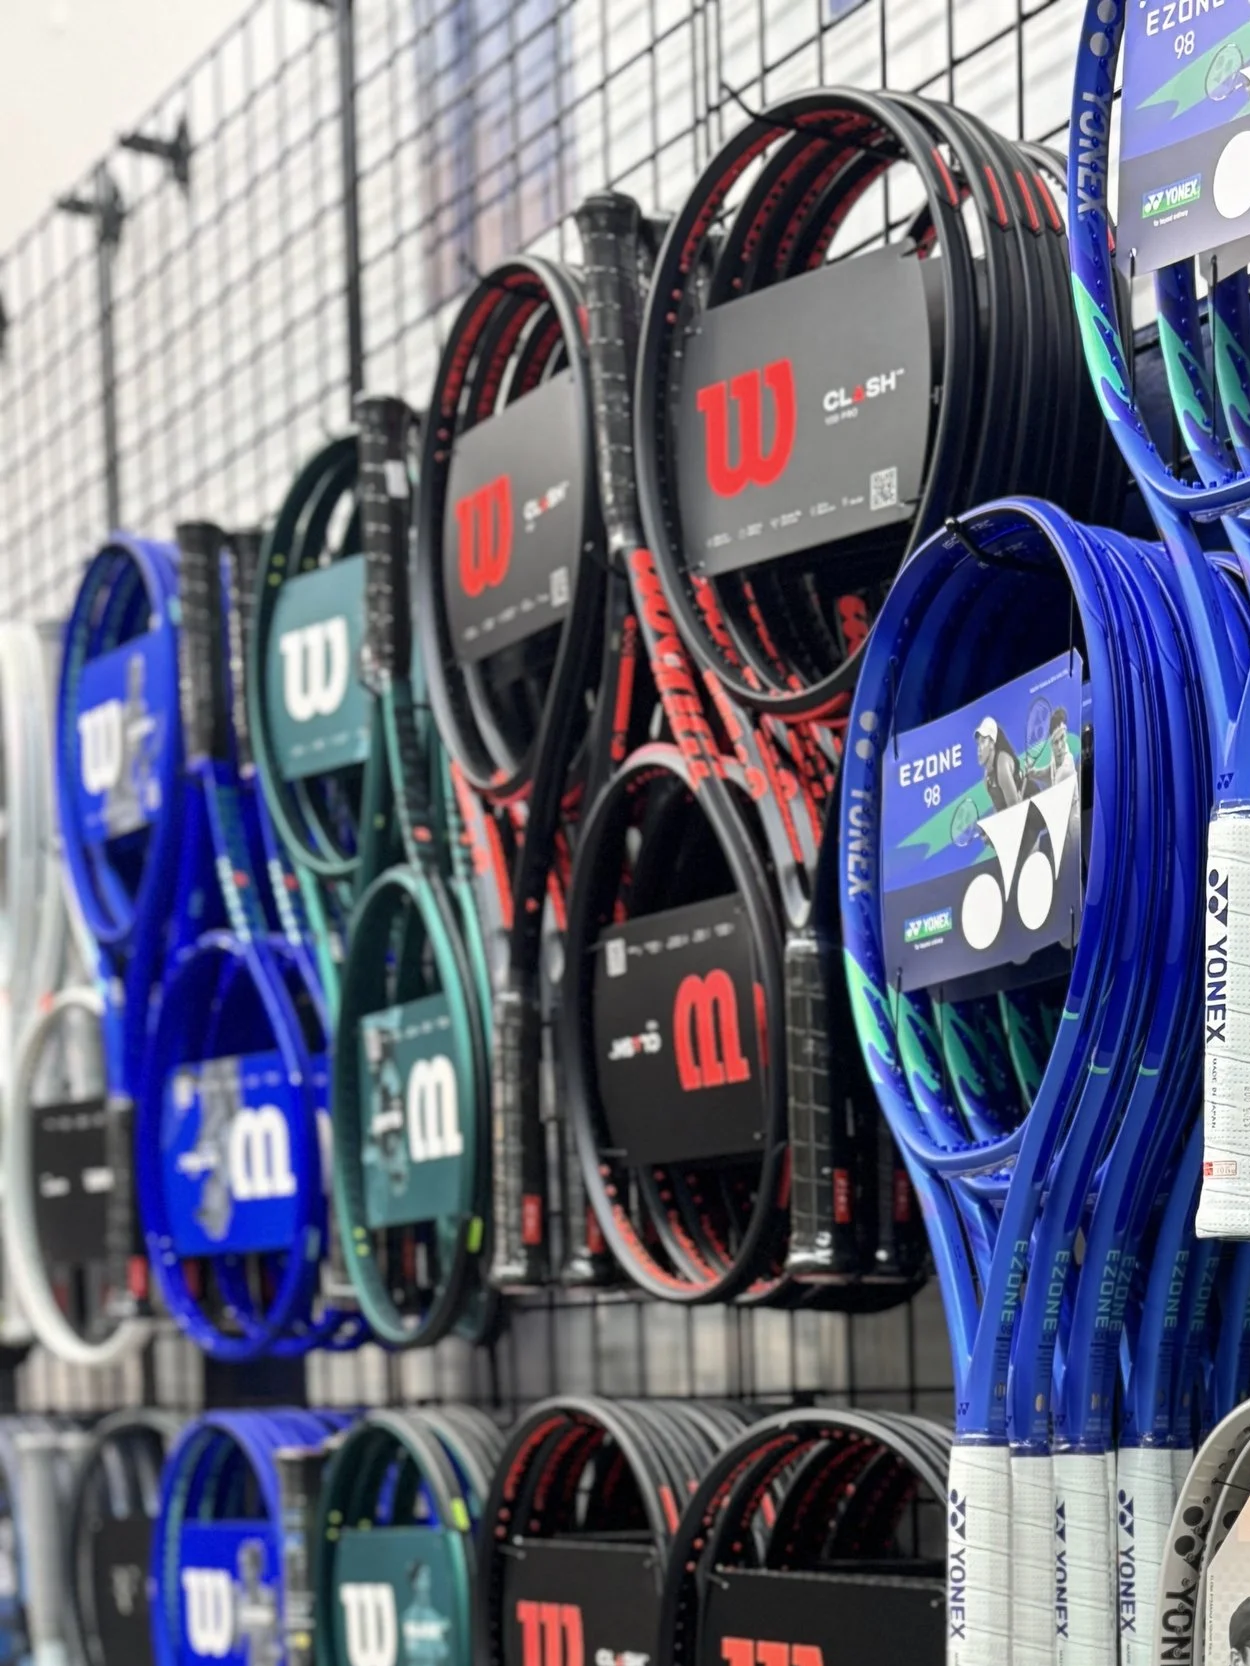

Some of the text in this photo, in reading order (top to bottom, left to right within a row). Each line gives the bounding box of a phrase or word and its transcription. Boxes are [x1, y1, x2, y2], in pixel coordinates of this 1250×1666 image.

[1146, 0, 1225, 36] EZON
[1174, 30, 1196, 60] 98
[1077, 91, 1107, 214] YONEX
[1165, 179, 1198, 207] YONEX
[899, 743, 962, 787] EZONE
[923, 784, 941, 808] 98
[923, 909, 952, 934] YONEX
[1206, 935, 1228, 1043] YONEX
[1001, 1240, 1028, 1322] EZONE
[1043, 1250, 1070, 1331] EZONE
[1094, 1250, 1121, 1329] EZONE
[1164, 1250, 1190, 1329] EZONE
[949, 1548, 966, 1640] YONEX
[1120, 1546, 1137, 1635] YONEX
